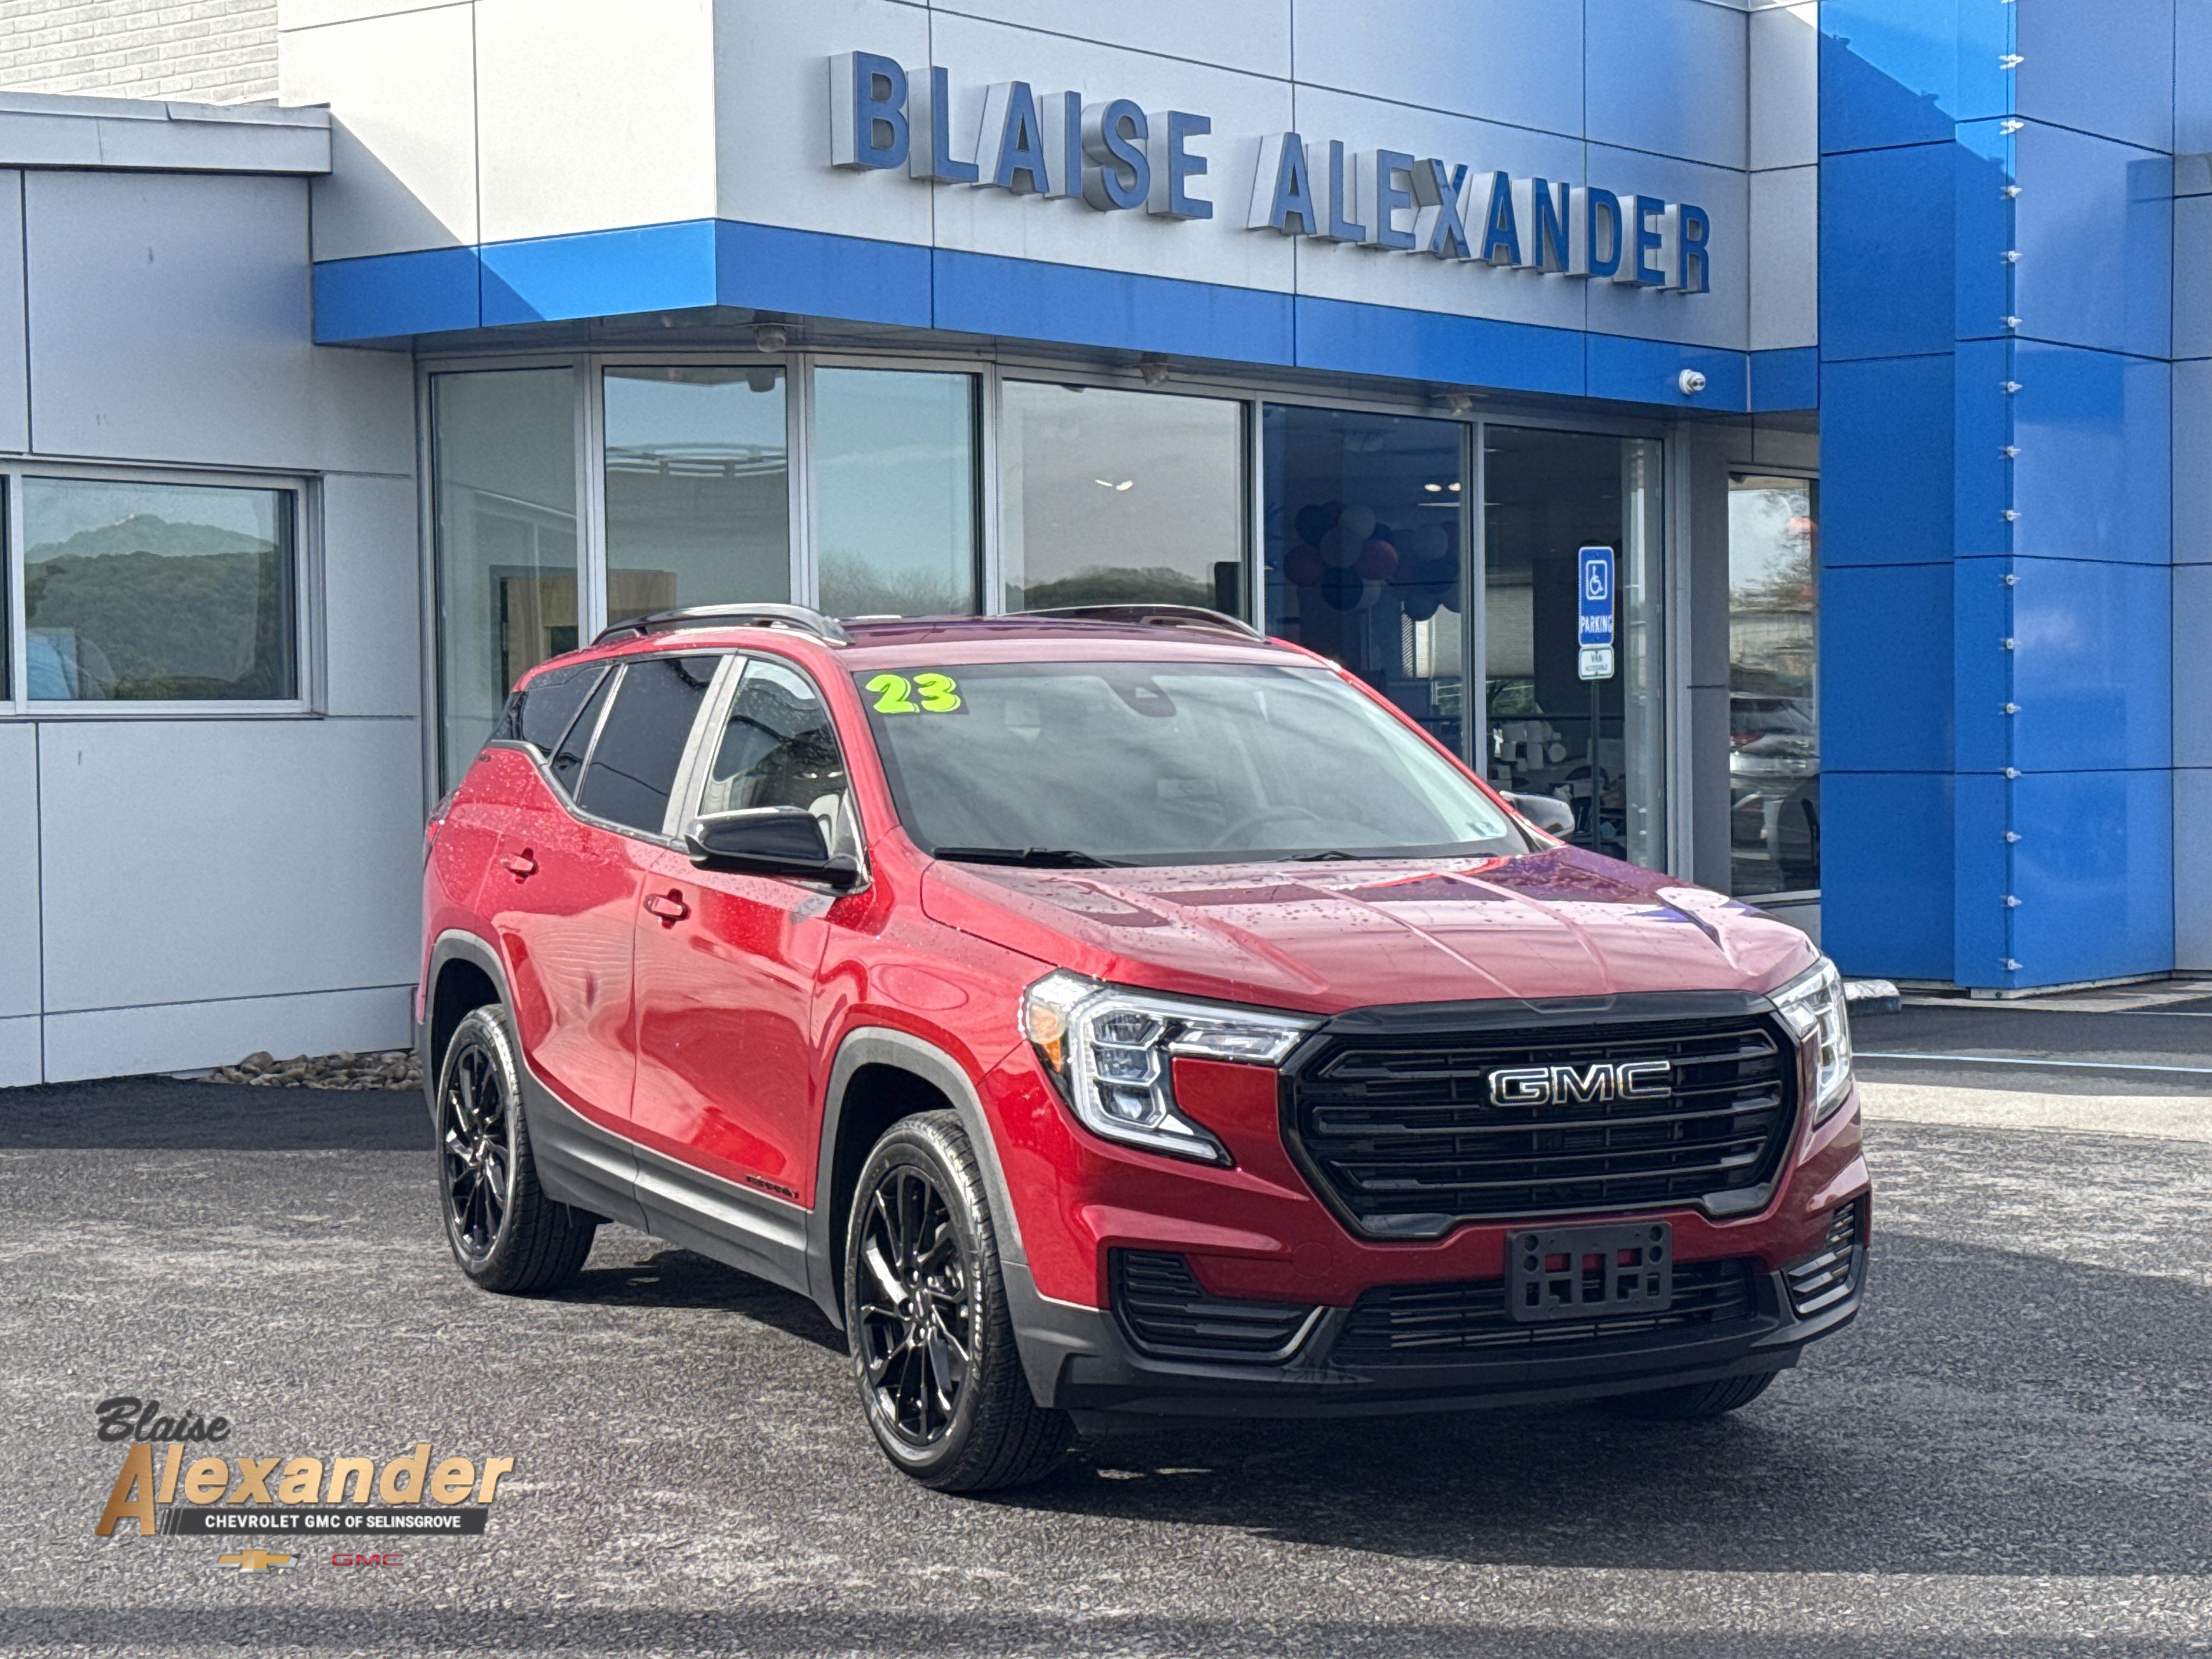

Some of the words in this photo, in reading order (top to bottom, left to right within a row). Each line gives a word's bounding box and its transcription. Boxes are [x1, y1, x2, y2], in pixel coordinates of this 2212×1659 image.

[833, 51, 1213, 220] BLAISE
[1249, 131, 1711, 295] ALEXANDER
[1581, 615, 1612, 633] PARKING
[865, 673, 961, 713] 23
[1488, 1060, 1672, 1107] GMC
